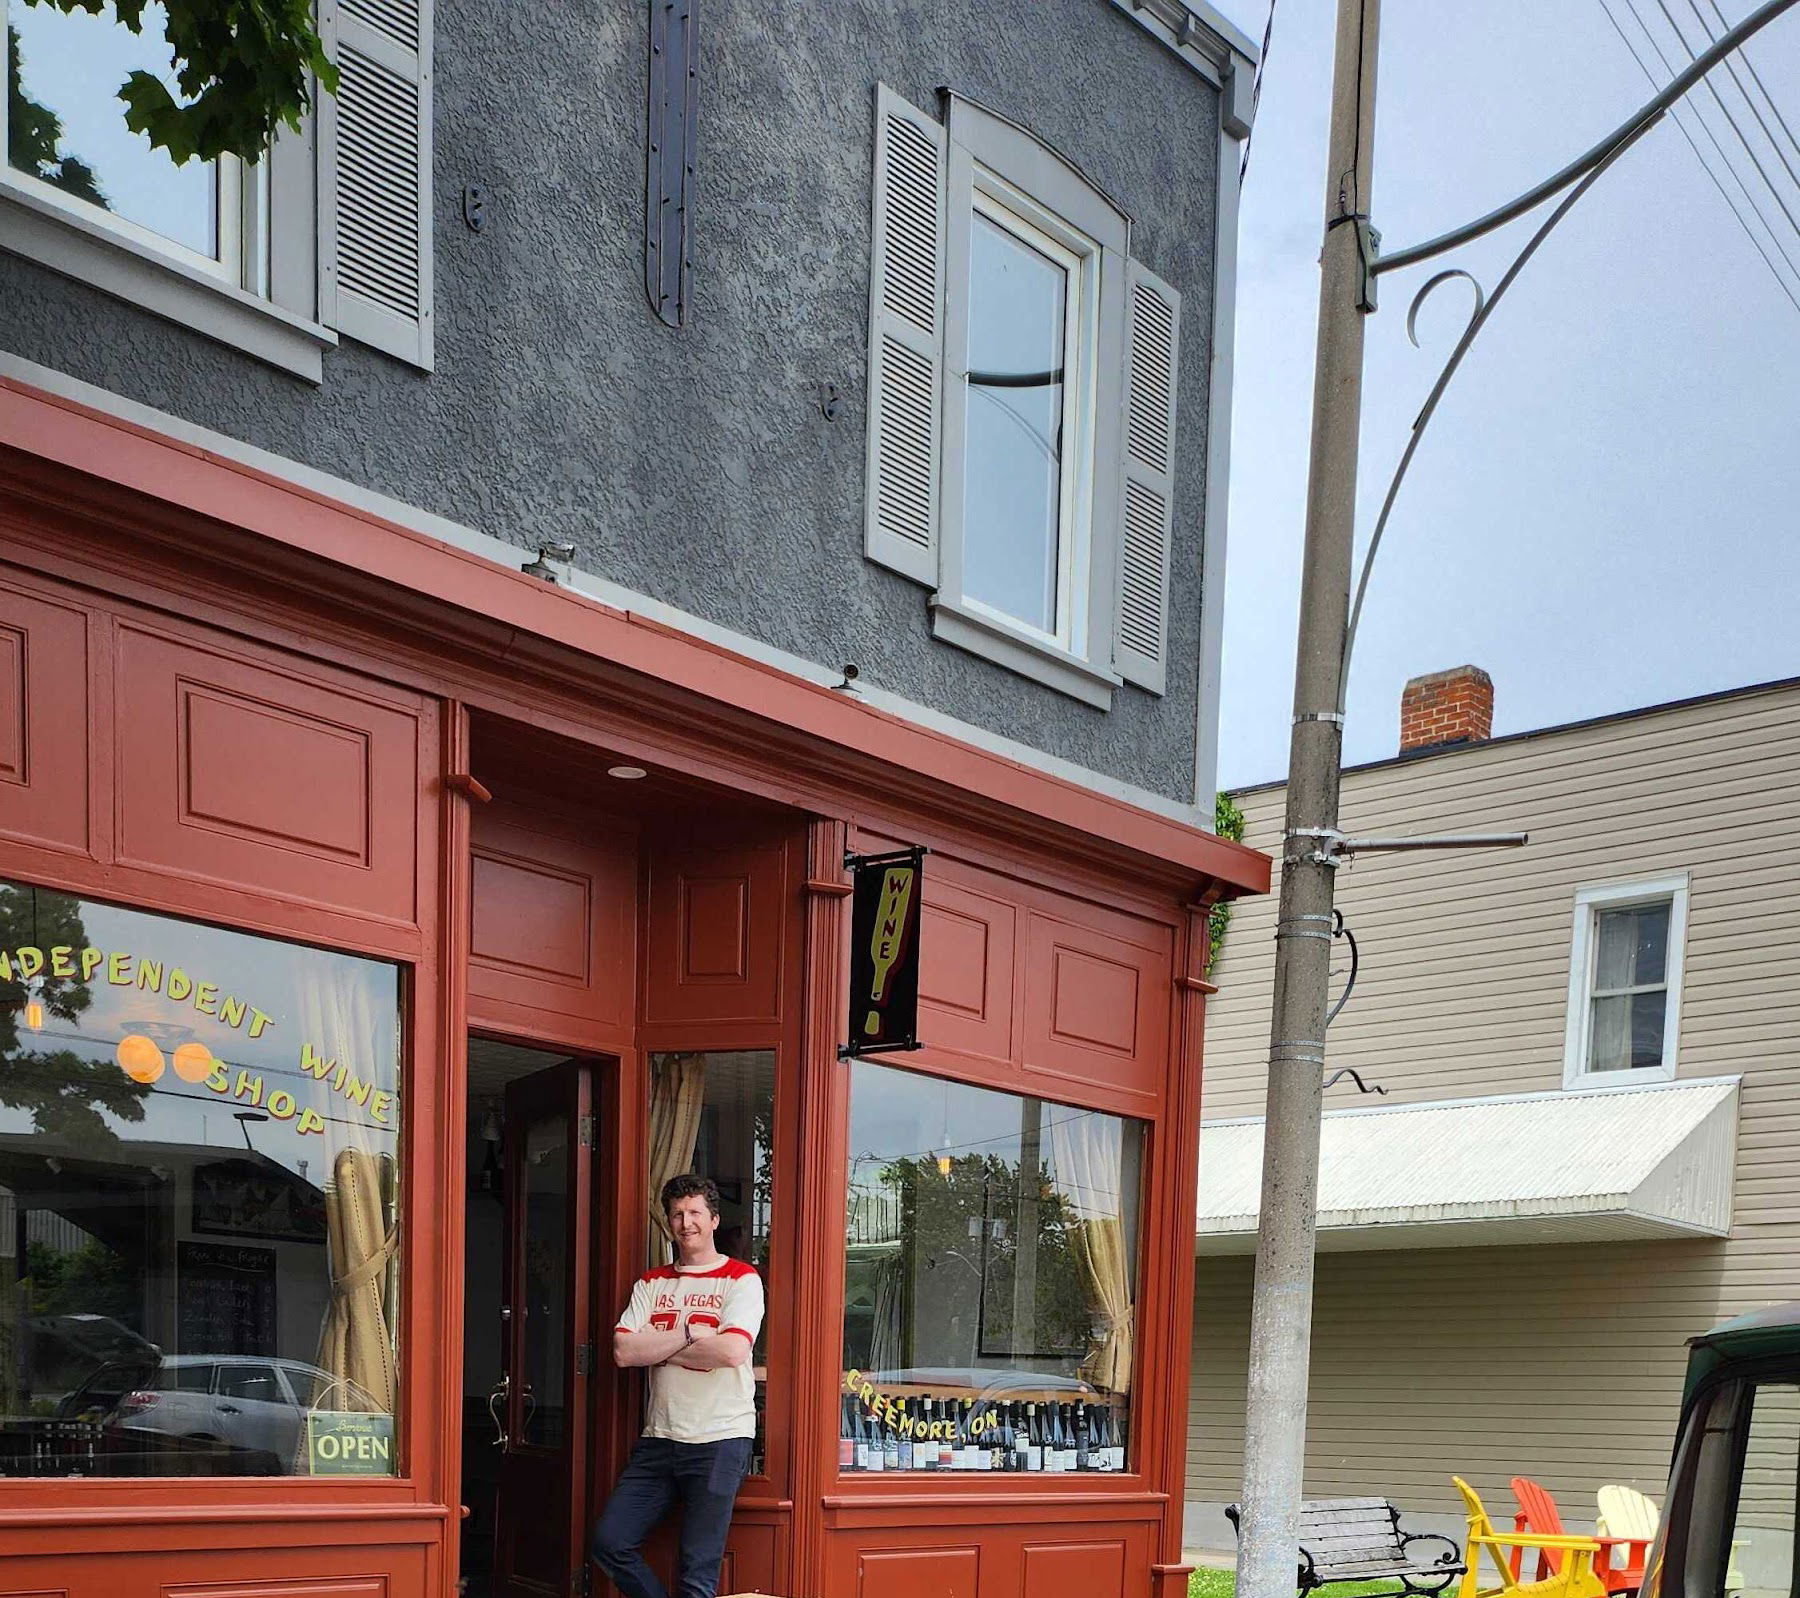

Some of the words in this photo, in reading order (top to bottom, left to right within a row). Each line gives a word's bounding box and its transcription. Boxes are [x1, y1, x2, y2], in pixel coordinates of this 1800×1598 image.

[879, 875, 909, 960] WINE
[204, 1059, 325, 1136] SHOP
[301, 1043, 392, 1124] WINE
[683, 1294, 723, 1309] VEGAS
[317, 1435, 389, 1459] OPEN
[971, 1411, 998, 1435] ON
